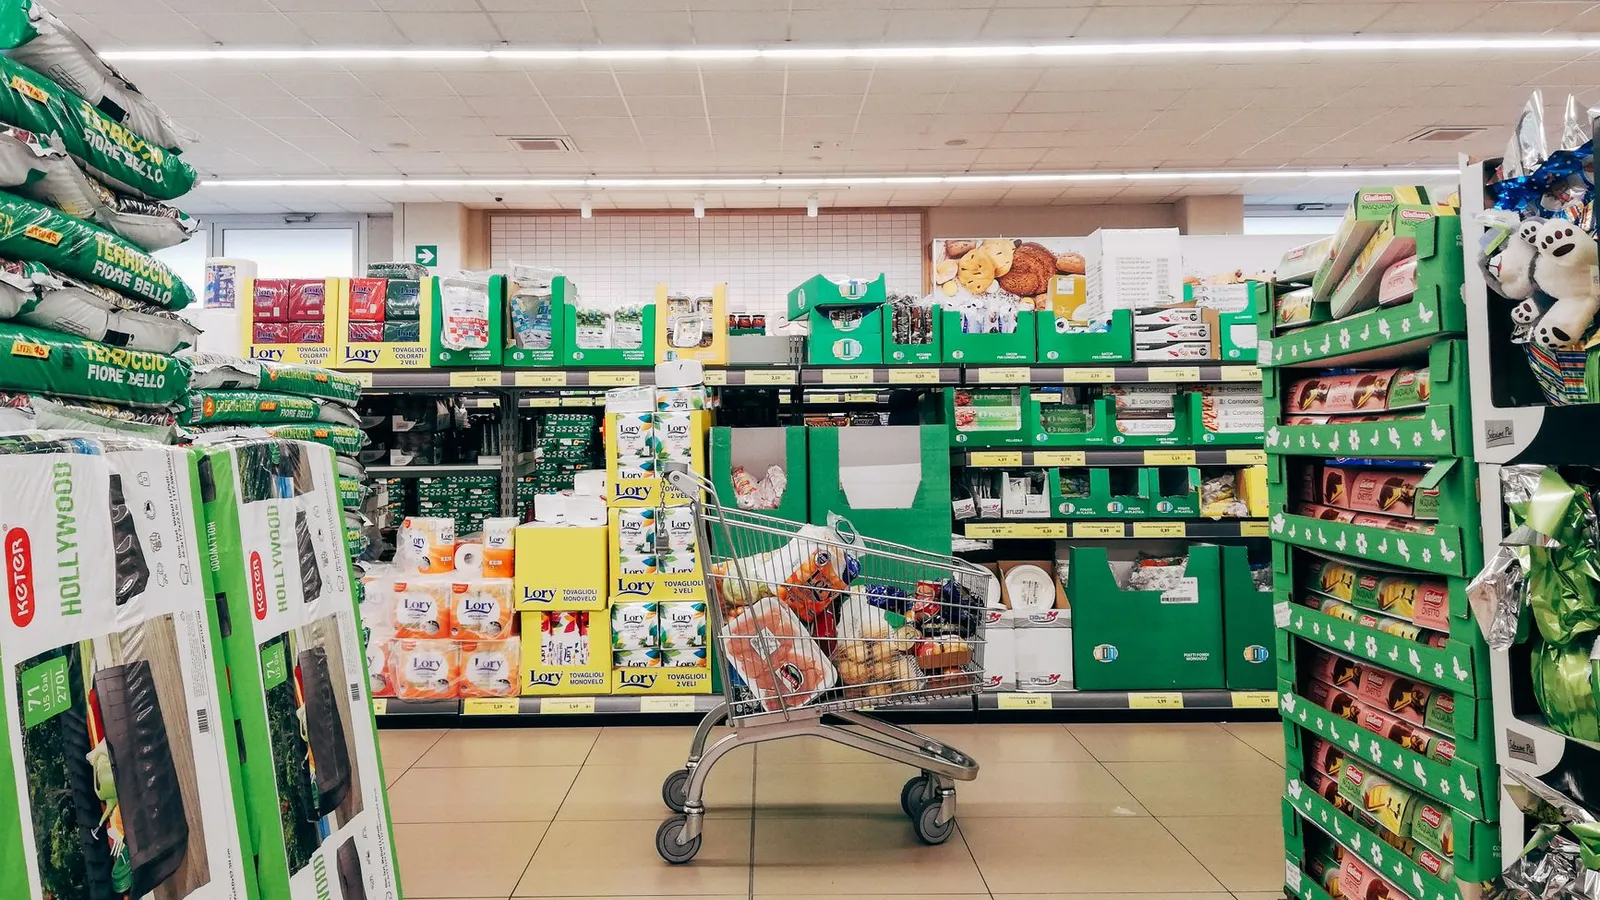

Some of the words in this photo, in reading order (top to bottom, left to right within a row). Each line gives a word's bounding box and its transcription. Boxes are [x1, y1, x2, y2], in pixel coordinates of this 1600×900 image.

[92, 260, 131, 287] FIORE
[133, 275, 172, 304] BELLO
[83, 341, 168, 372] TERRICCIO
[250, 346, 285, 361] Lory
[345, 346, 381, 362] Lory
[87, 364, 124, 384] FIORE
[128, 372, 165, 389] BELLO
[206, 402, 212, 412] 2
[280, 409, 296, 418] FIORE
[297, 410, 313, 418] BELLO
[620, 424, 641, 434] Lory
[667, 424, 688, 434] Lory
[1141, 422, 1173, 430] Cartaforno
[622, 471, 642, 479] Lory
[615, 483, 651, 499] Lory
[622, 519, 642, 529] Lory
[671, 519, 692, 529] Lory
[53, 461, 82, 616] HOLLYWOOD
[489, 536, 505, 544] Lory
[207, 521, 220, 572] HOLLYWOOD
[267, 504, 288, 613] HOLLYWOOD
[11, 537, 29, 617] KETER
[252, 558, 265, 613] KETER
[618, 579, 655, 595] Lory
[524, 587, 556, 601] Lory
[404, 599, 432, 612] Lory
[465, 599, 495, 613] Lory
[624, 613, 644, 623] Lory
[672, 613, 693, 623] Lory
[266, 661, 274, 680] 71
[414, 657, 442, 670] Lory
[475, 657, 504, 670] Lory
[41, 672, 49, 693] Gal
[56, 663, 66, 704] 270L
[530, 670, 563, 685] Lory
[620, 671, 657, 687] Lory
[28, 684, 41, 713] 71
[43, 696, 50, 712] US
